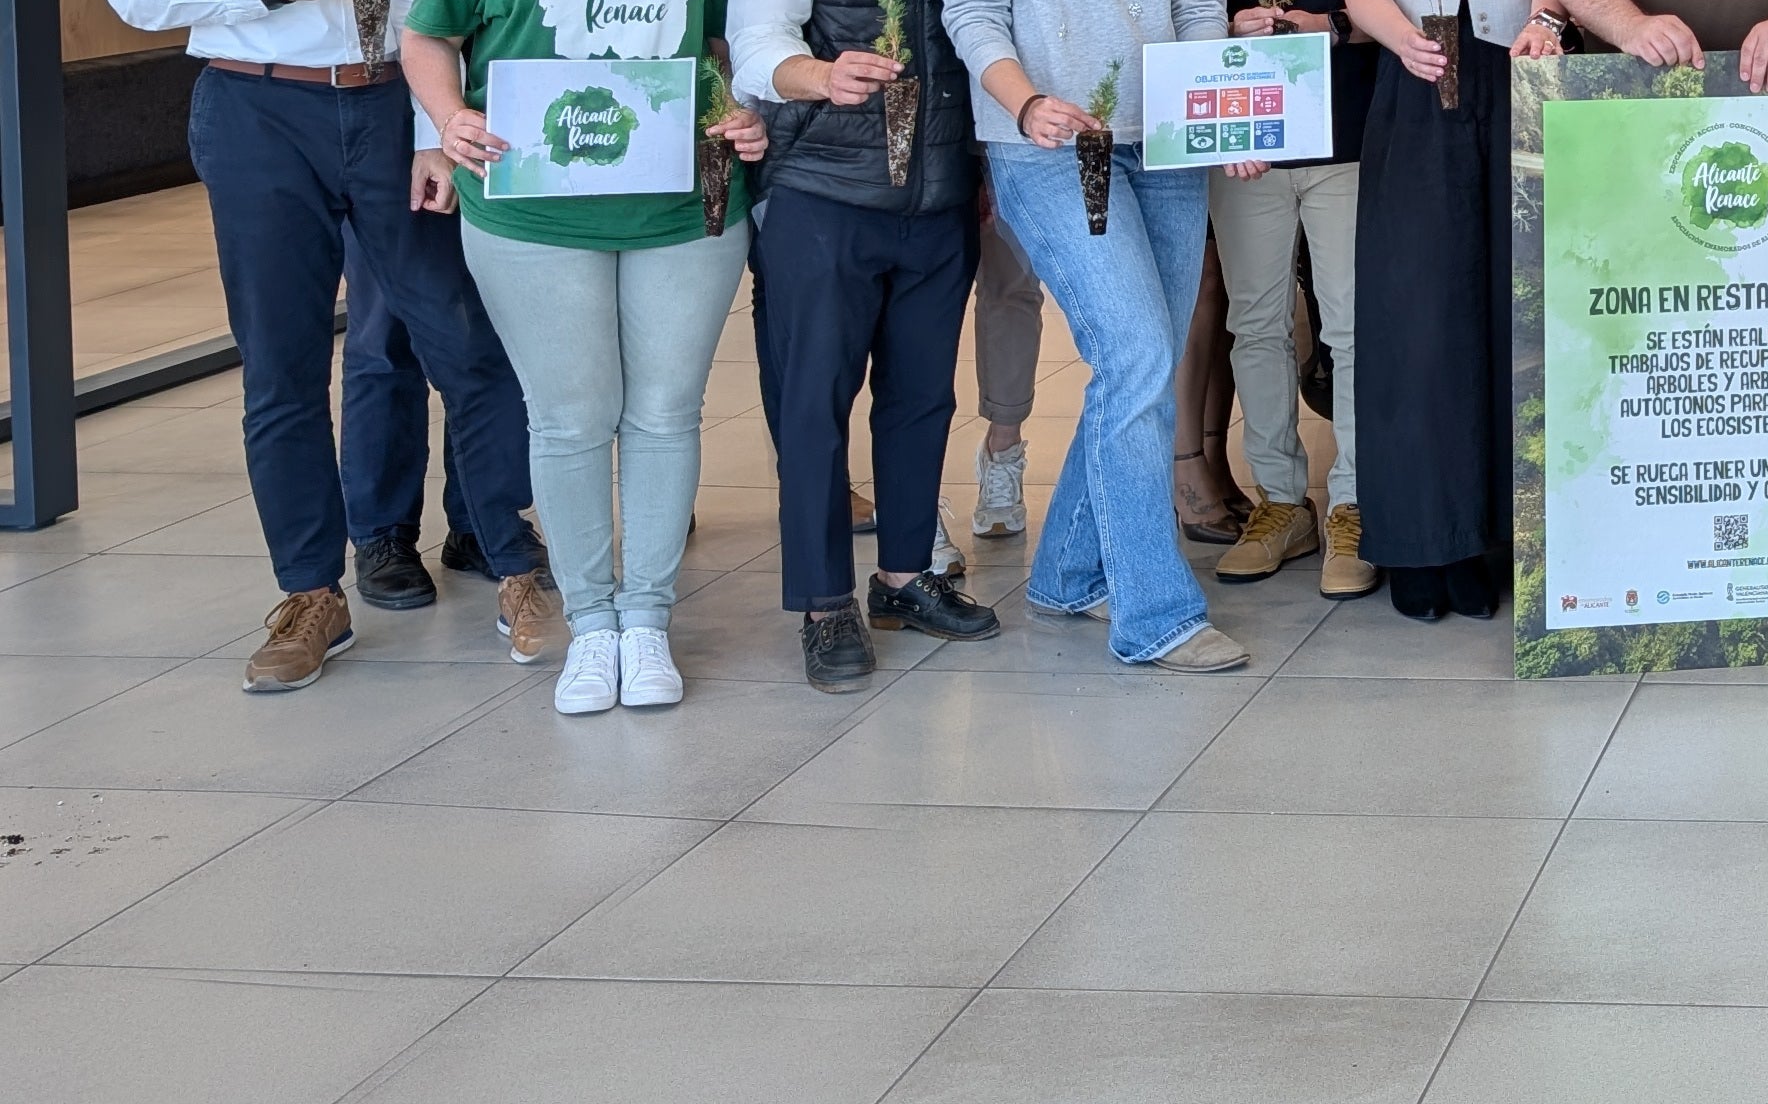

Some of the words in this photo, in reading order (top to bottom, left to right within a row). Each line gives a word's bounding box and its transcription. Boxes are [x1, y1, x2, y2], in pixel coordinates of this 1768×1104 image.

[1194, 72, 1246, 84] OBJETIVOS
[556, 105, 622, 129] Alicante
[568, 125, 620, 151] Renace
[1668, 136, 1695, 175] EDUCACIÓN
[1697, 122, 1725, 138] ACCIÓN
[1692, 162, 1761, 189] Alicante
[1705, 185, 1760, 214] Renace
[1589, 286, 1651, 316] ZONA
[1659, 284, 1690, 313] EN
[1646, 331, 1667, 351] SE
[1671, 323, 1724, 349] ESTÁN
[1608, 352, 1691, 375] TRABAJOS
[1695, 351, 1715, 371] DE
[1646, 370, 1718, 395] ÁRBOLES
[1723, 371, 1735, 392] Y
[1620, 391, 1726, 418] AUTÓCTONOS
[1661, 418, 1692, 439] LOS
[1610, 465, 1631, 486] SE
[1636, 462, 1689, 484] RUEGA
[1693, 460, 1746, 481] TENER
[1634, 483, 1742, 507] SENSIBILIDAD
[1746, 480, 1759, 501] Y
